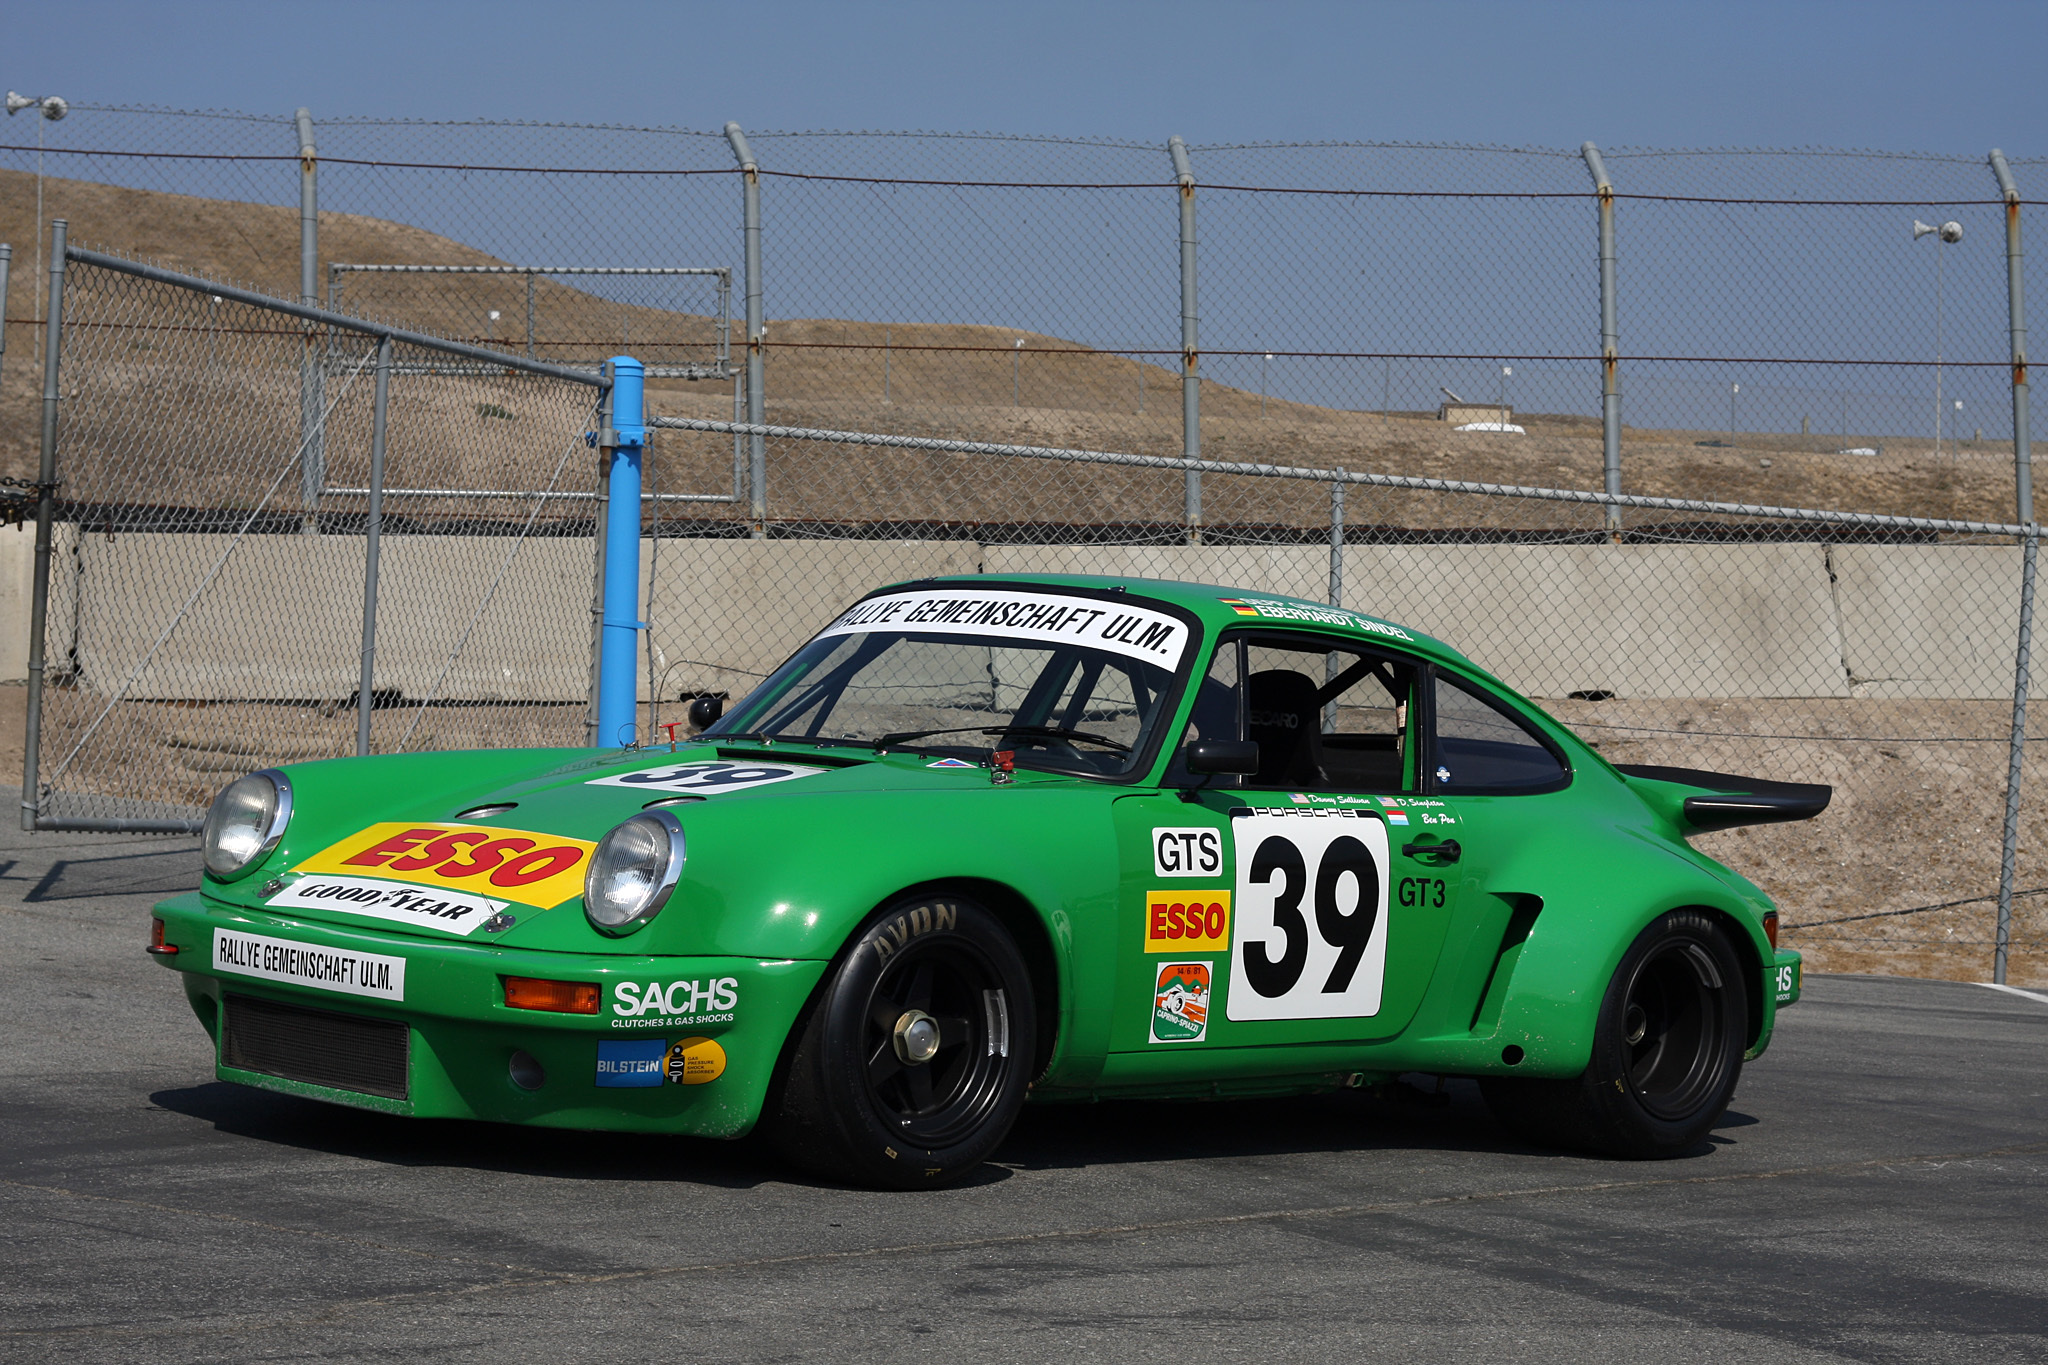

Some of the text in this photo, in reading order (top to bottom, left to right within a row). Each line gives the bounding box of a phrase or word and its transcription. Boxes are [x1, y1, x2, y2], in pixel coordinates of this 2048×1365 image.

[903, 599, 1106, 635] GEMEINSCHAFT
[1100, 613, 1176, 655] ULM.
[1254, 605, 1414, 641] EBERHARDT SINDEL
[1247, 709, 1299, 729] ECARO
[618, 763, 794, 788] 39
[1252, 806, 1357, 819] PORSCHE
[1308, 794, 1371, 805] Danny Sullivan
[1421, 813, 1437, 824] Ben
[340, 828, 584, 888] ESSO
[1157, 831, 1220, 872] GTS
[871, 903, 957, 968] AVON
[1149, 902, 1226, 940] ESSO
[1242, 835, 1380, 999] 39
[219, 936, 393, 991] RALLYE GEMEINSCHAFT ULM.
[612, 976, 739, 1017] SACHS
[611, 1013, 734, 1029] CLUTCHES & GAS SHOCKS
[597, 1060, 660, 1073] BILSTEIN
